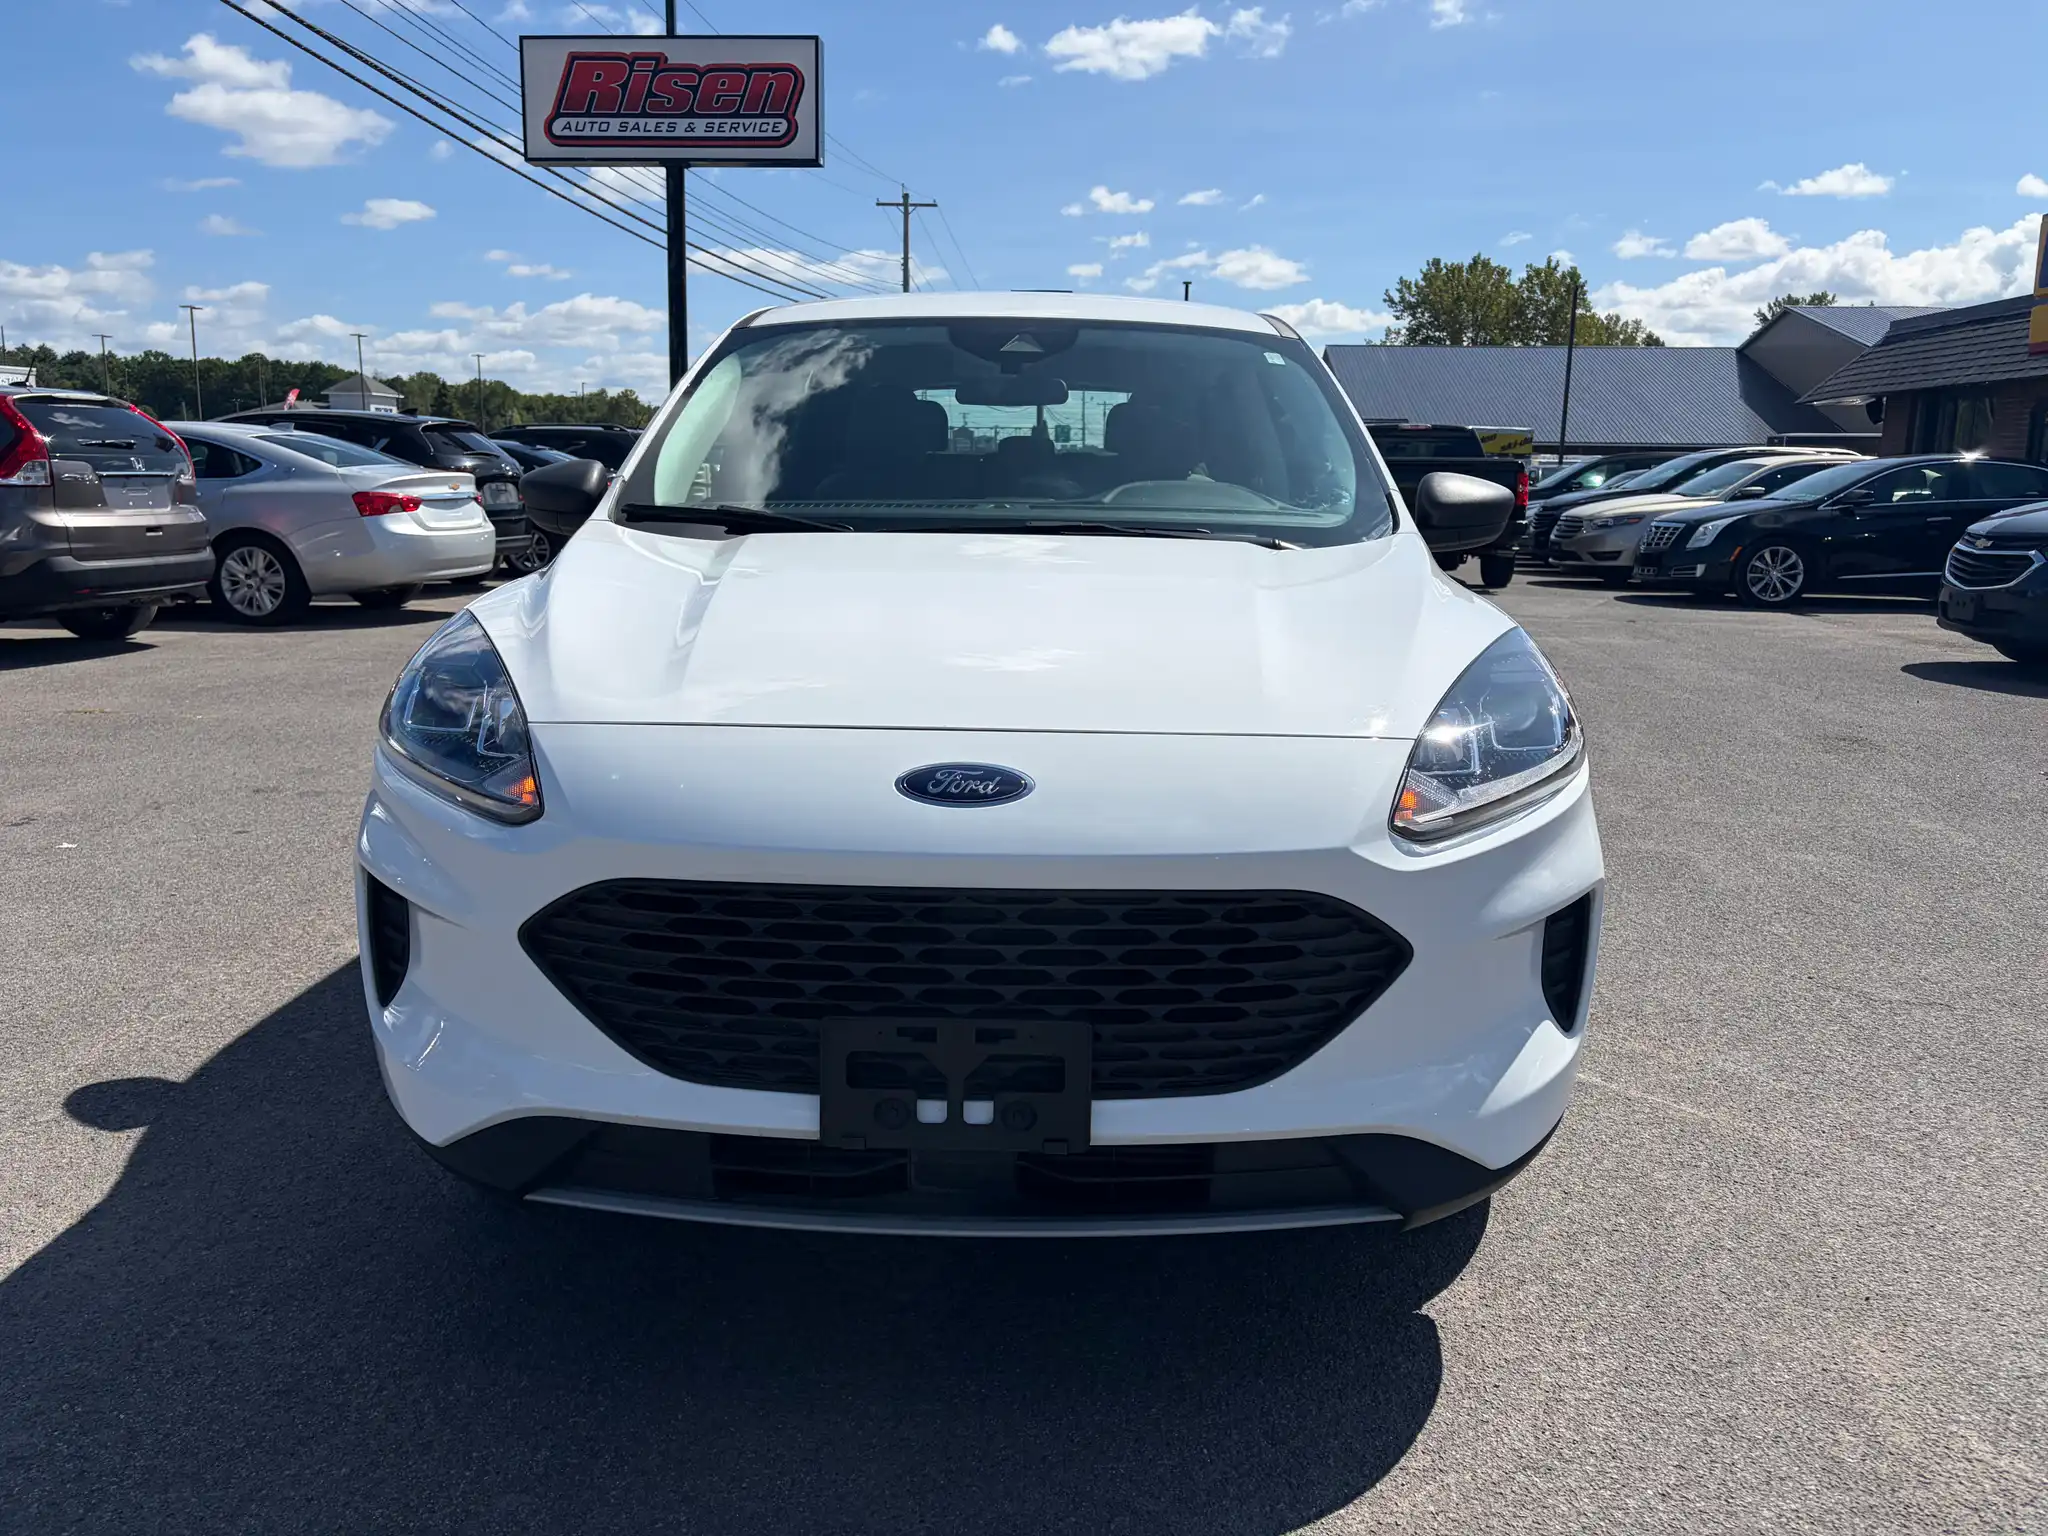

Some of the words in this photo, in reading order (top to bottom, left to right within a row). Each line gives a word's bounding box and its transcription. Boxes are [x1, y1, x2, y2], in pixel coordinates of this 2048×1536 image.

[560, 59, 796, 114] Risen
[560, 120, 612, 133] AUTO
[617, 120, 677, 134] SALES
[684, 120, 697, 134] &
[703, 121, 783, 134] SERVICE
[927, 769, 1002, 795] Ford
